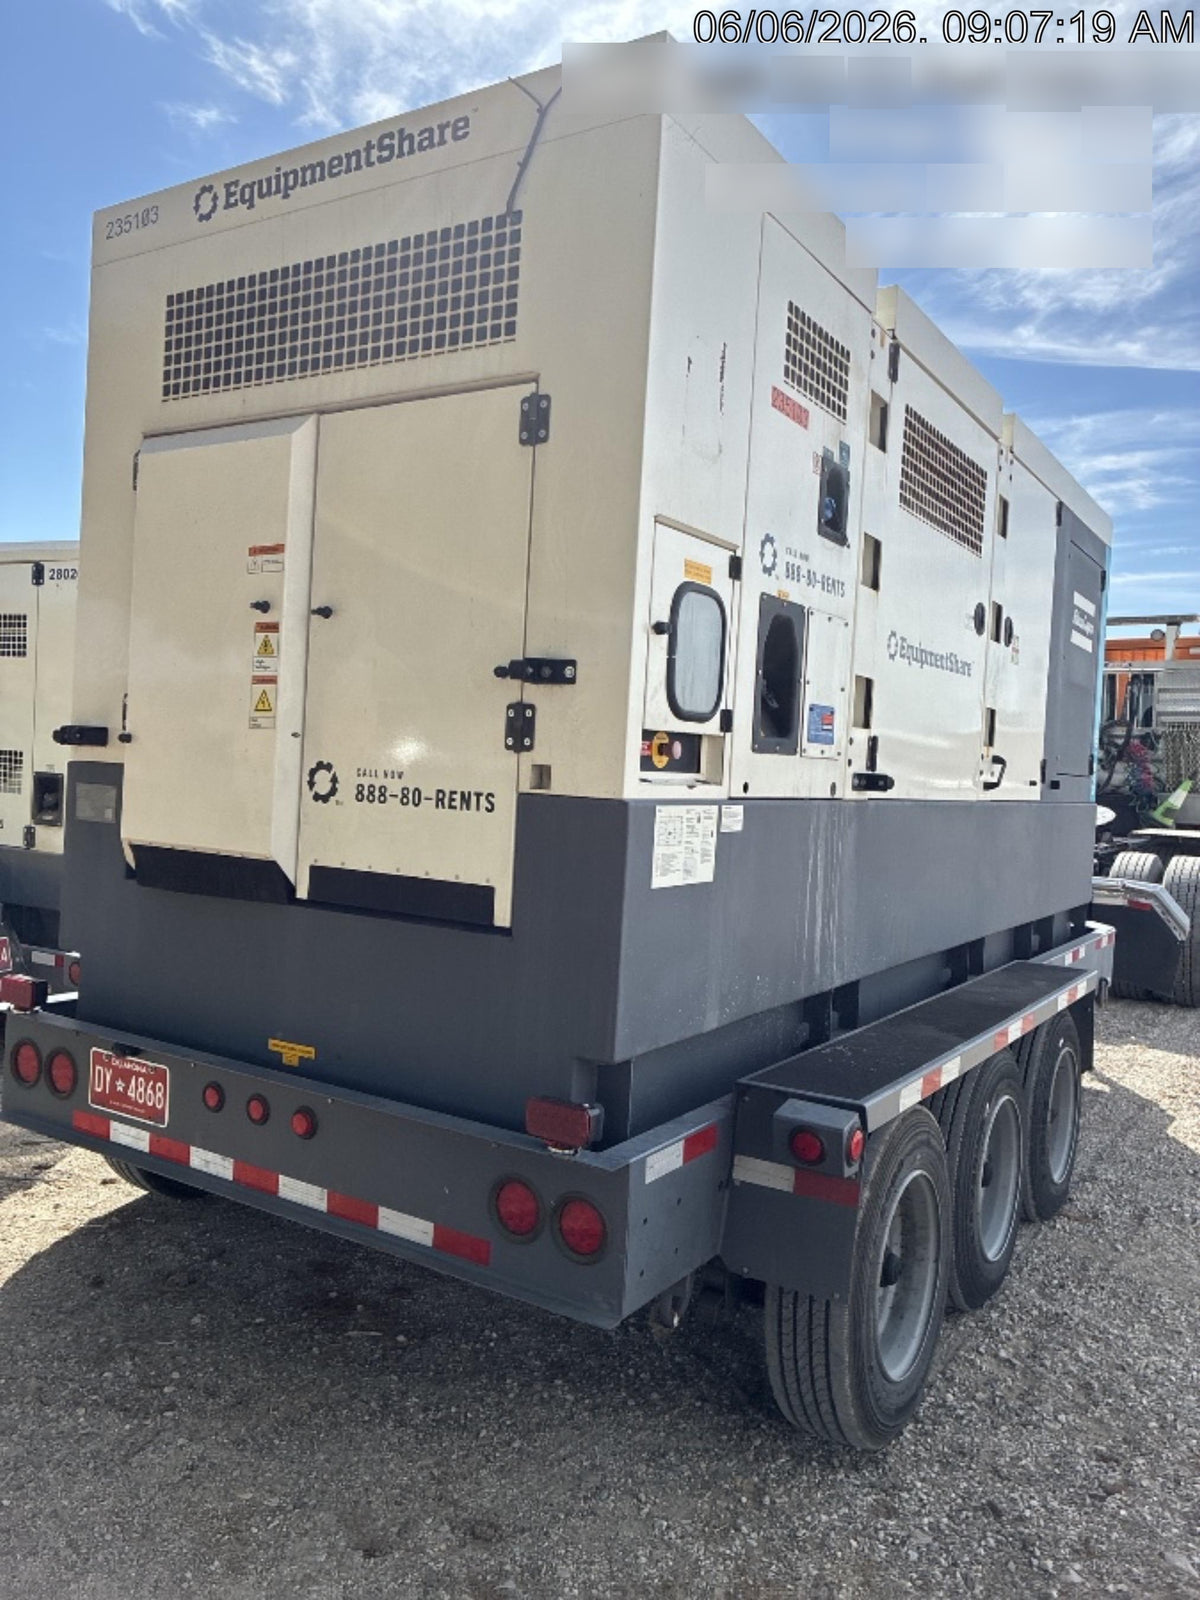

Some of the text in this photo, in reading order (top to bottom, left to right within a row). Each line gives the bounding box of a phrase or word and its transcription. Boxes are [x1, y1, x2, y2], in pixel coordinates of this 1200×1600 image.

[223, 115, 470, 211] EquipmentShare
[105, 205, 160, 239] 235103
[49, 568, 78, 580] 2802
[899, 636, 972, 677] EquipmentShare
[356, 768, 404, 780] CALL NOW
[355, 783, 496, 813] 888-80-RENTS
[94, 1065, 112, 1094] DY
[127, 1075, 165, 1110] 4868
